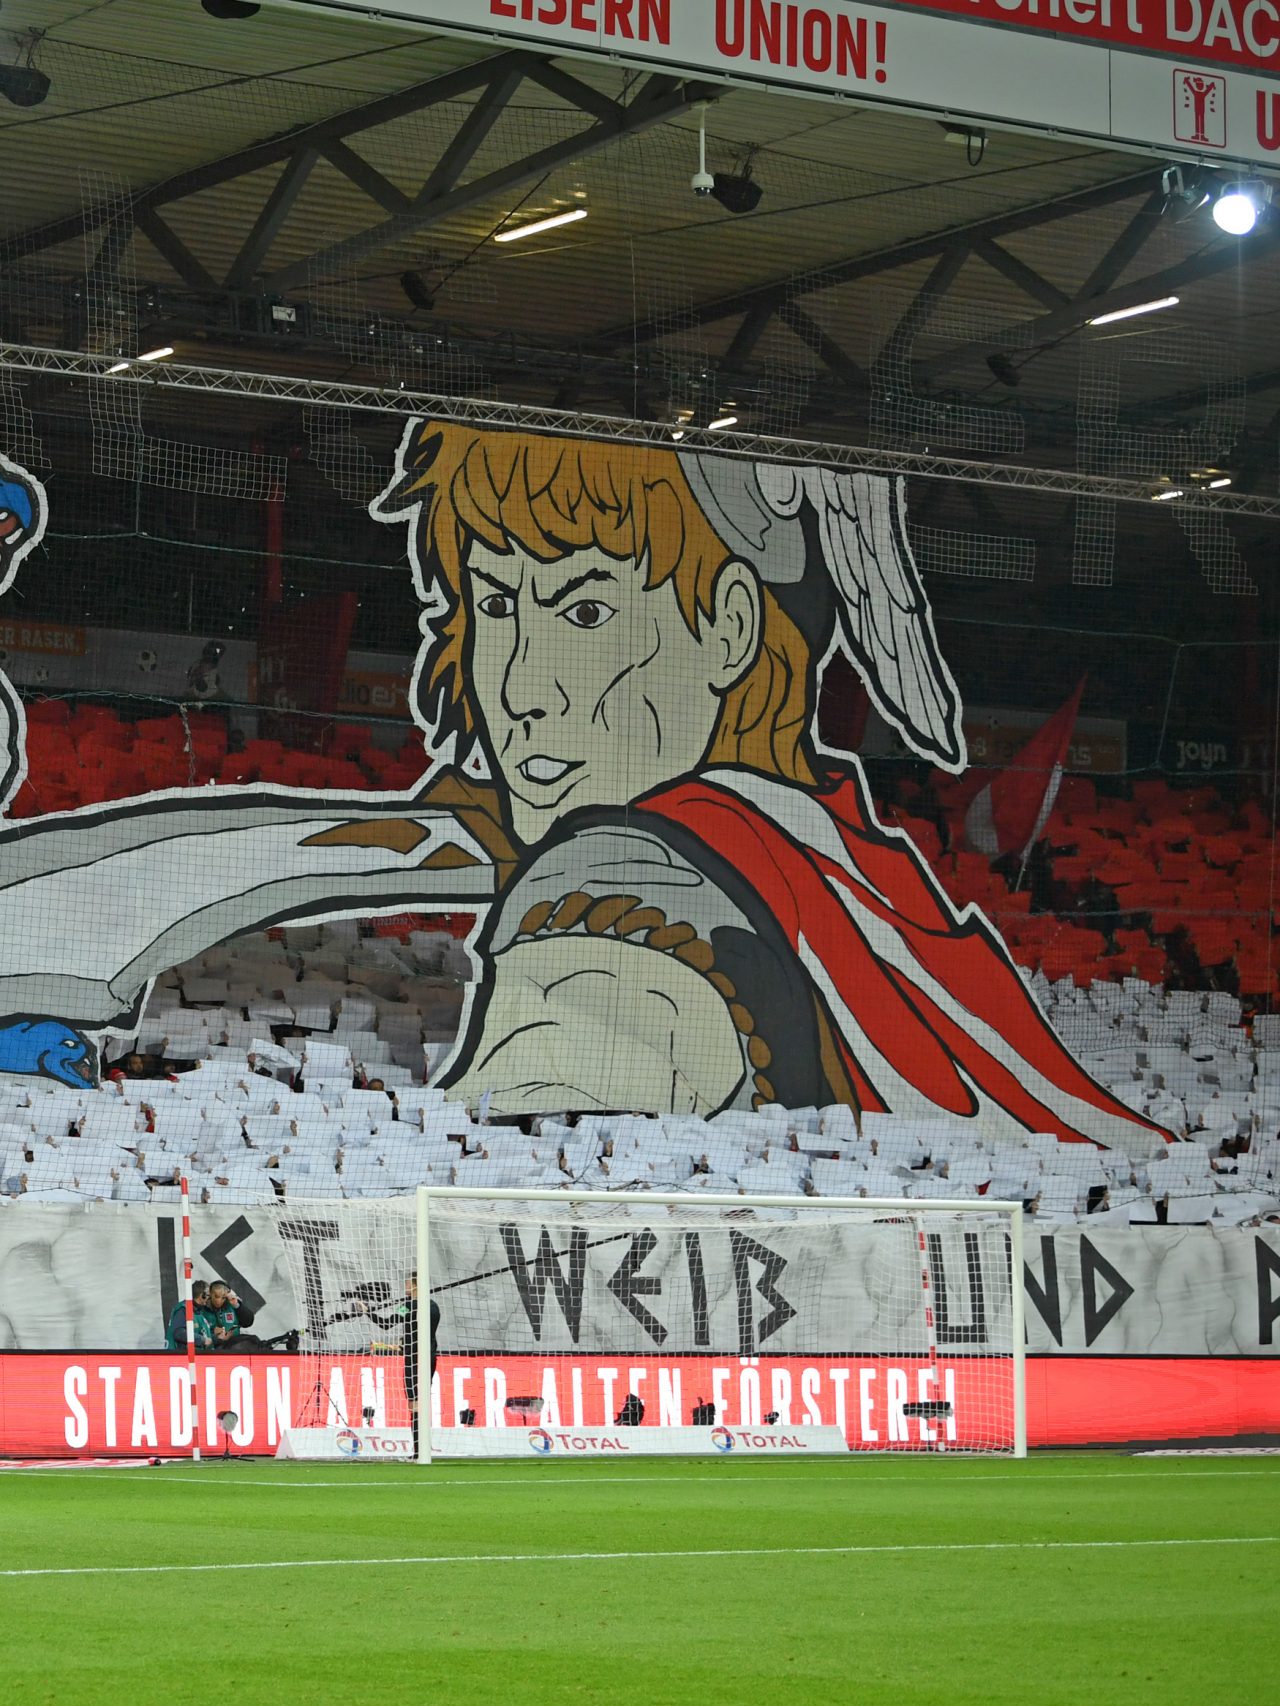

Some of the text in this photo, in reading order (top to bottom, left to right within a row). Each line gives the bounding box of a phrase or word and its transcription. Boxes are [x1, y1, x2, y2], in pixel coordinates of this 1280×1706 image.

[714, 0, 885, 83] UNION!
[157, 1213, 341, 1341] IST
[926, 1230, 1135, 1348] UND
[63, 1365, 291, 1449] STADION
[326, 1366, 387, 1428] AN
[539, 1366, 682, 1428] ALTEN
[711, 1356, 957, 1441] FÖRSTEREI
[555, 1432, 630, 1452] TOTAL
[736, 1431, 808, 1449] TOTAL
